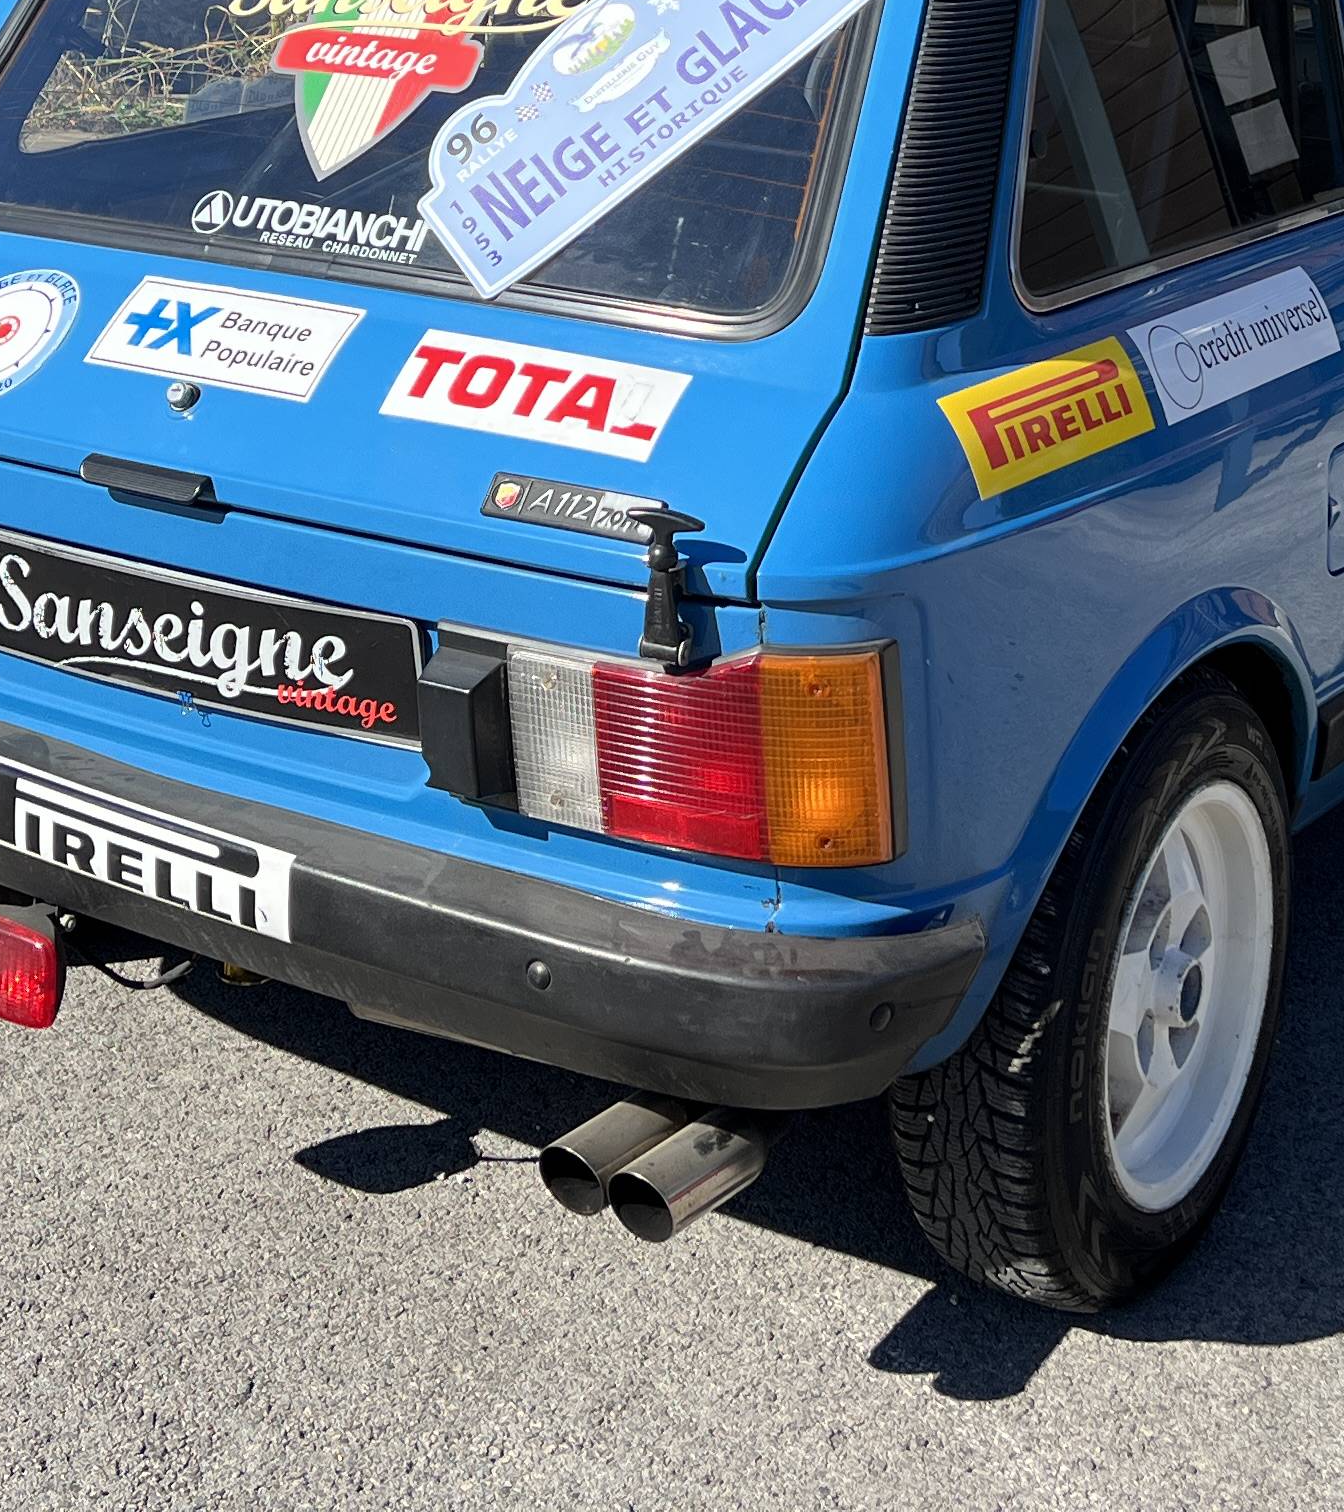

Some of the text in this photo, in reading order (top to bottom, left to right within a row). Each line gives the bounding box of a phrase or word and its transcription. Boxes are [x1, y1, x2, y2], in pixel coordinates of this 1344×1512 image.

[306, 37, 437, 82] vintage
[447, 113, 498, 165] 96
[597, 65, 749, 188] HISTORIQUE
[456, 128, 518, 183] RALLYE
[469, 121, 622, 242] NEIGE
[623, 86, 673, 135] ET
[259, 231, 417, 264] RESEAU CHARDONNET
[449, 200, 503, 267] 1953
[45, 272, 77, 306] GLACE
[220, 311, 312, 342] Banque
[1252, 287, 1327, 351] universel
[200, 339, 315, 377] Populaire
[966, 359, 1132, 470] PIRELLI
[529, 489, 597, 521] A112
[277, 681, 398, 729] vintage
